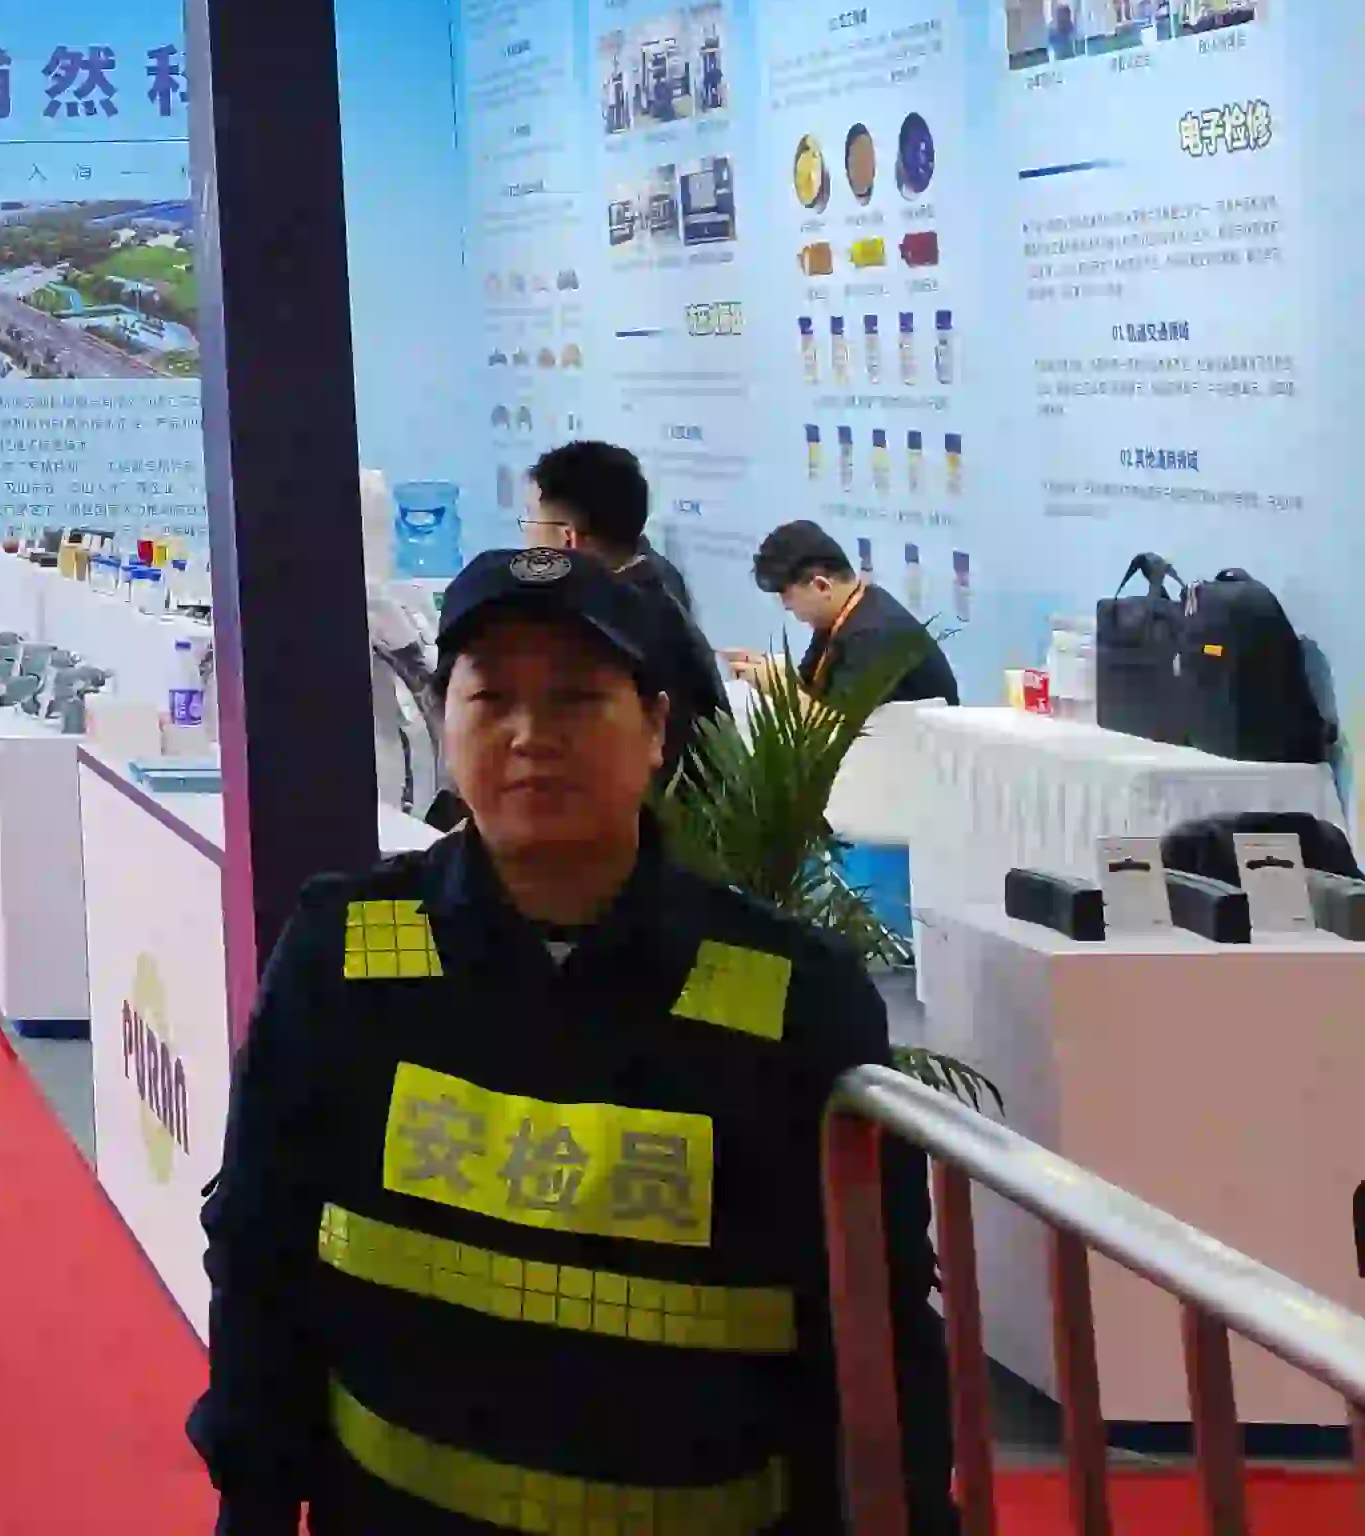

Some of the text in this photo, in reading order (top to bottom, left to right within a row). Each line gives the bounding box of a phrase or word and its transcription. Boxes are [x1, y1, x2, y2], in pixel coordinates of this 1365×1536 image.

[1180, 99, 1271, 156] 电子检修
[122, 999, 190, 1155] PURAN
[395, 1092, 698, 1229] 安检员
